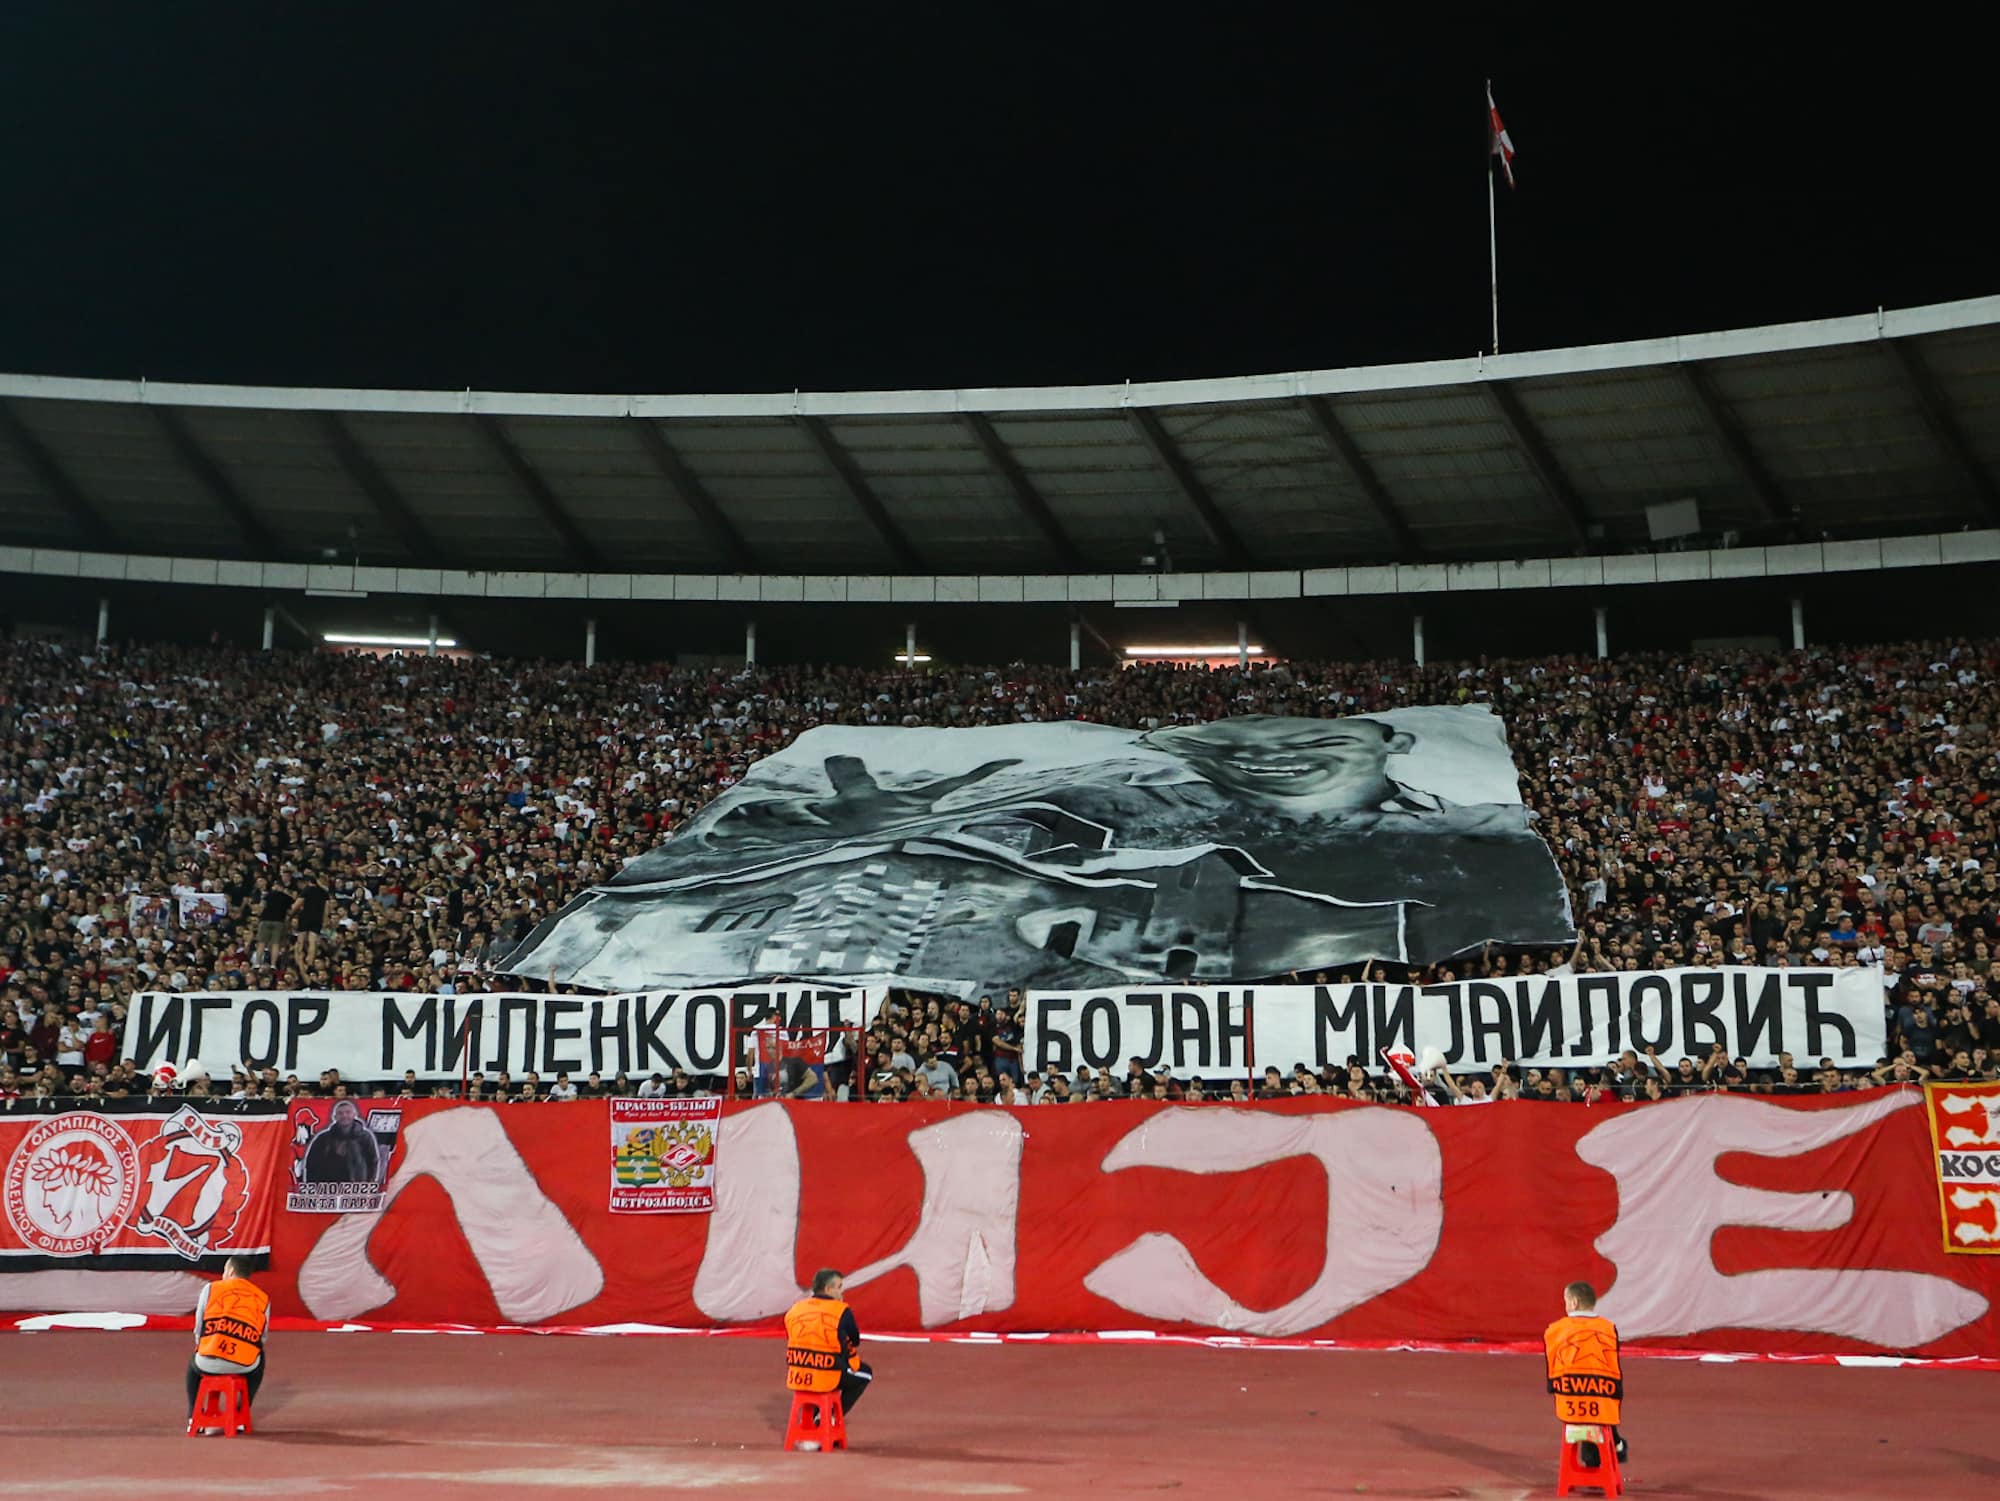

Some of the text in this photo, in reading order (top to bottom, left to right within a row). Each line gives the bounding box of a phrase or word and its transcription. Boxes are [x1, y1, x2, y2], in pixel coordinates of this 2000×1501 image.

[134, 996, 330, 1070] ИГОР
[1036, 990, 1255, 1072] БОЈАН
[31, 1116, 123, 1146] ΟΛΥΜΠΙΑΚΟΣ
[299, 1183, 378, 1195] 22/10/2022
[612, 1196, 711, 1209] ПЕТРОЗАВОДСК
[218, 1340, 237, 1355] 43
[1566, 1401, 1599, 1416] 358
